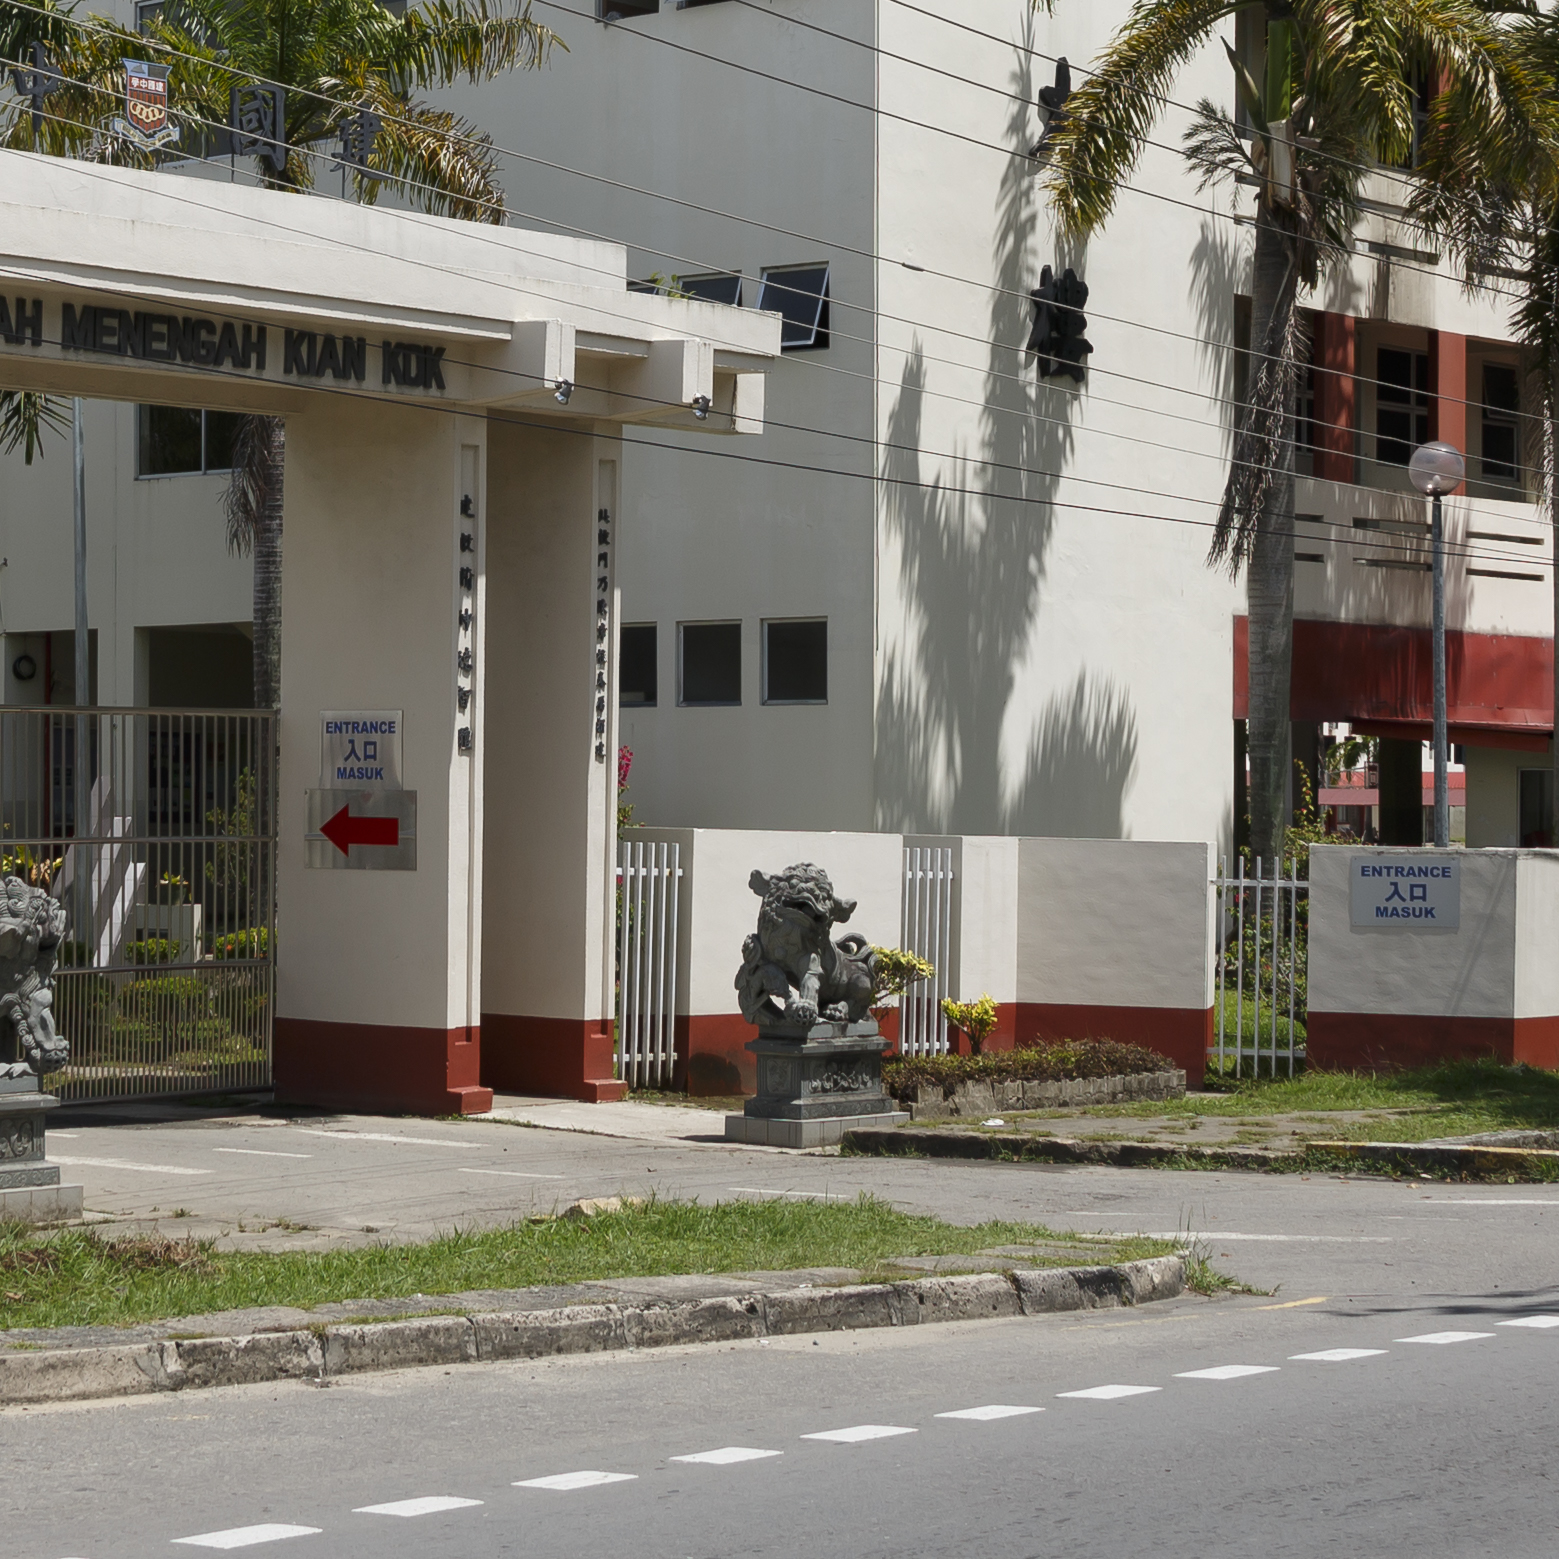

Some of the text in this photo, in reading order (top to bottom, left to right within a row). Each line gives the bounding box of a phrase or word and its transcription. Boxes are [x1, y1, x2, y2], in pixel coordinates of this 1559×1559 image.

[61, 302, 267, 371] MENENGAH
[284, 330, 367, 383] KIAN
[382, 340, 446, 390] KOK
[325, 721, 396, 735] ENTRANCE
[344, 738, 378, 762] 入口
[336, 767, 384, 781] MASUK
[1360, 865, 1452, 878] ENTRANCE
[1384, 882, 1427, 902] 入口
[1375, 906, 1436, 919] MASUK
